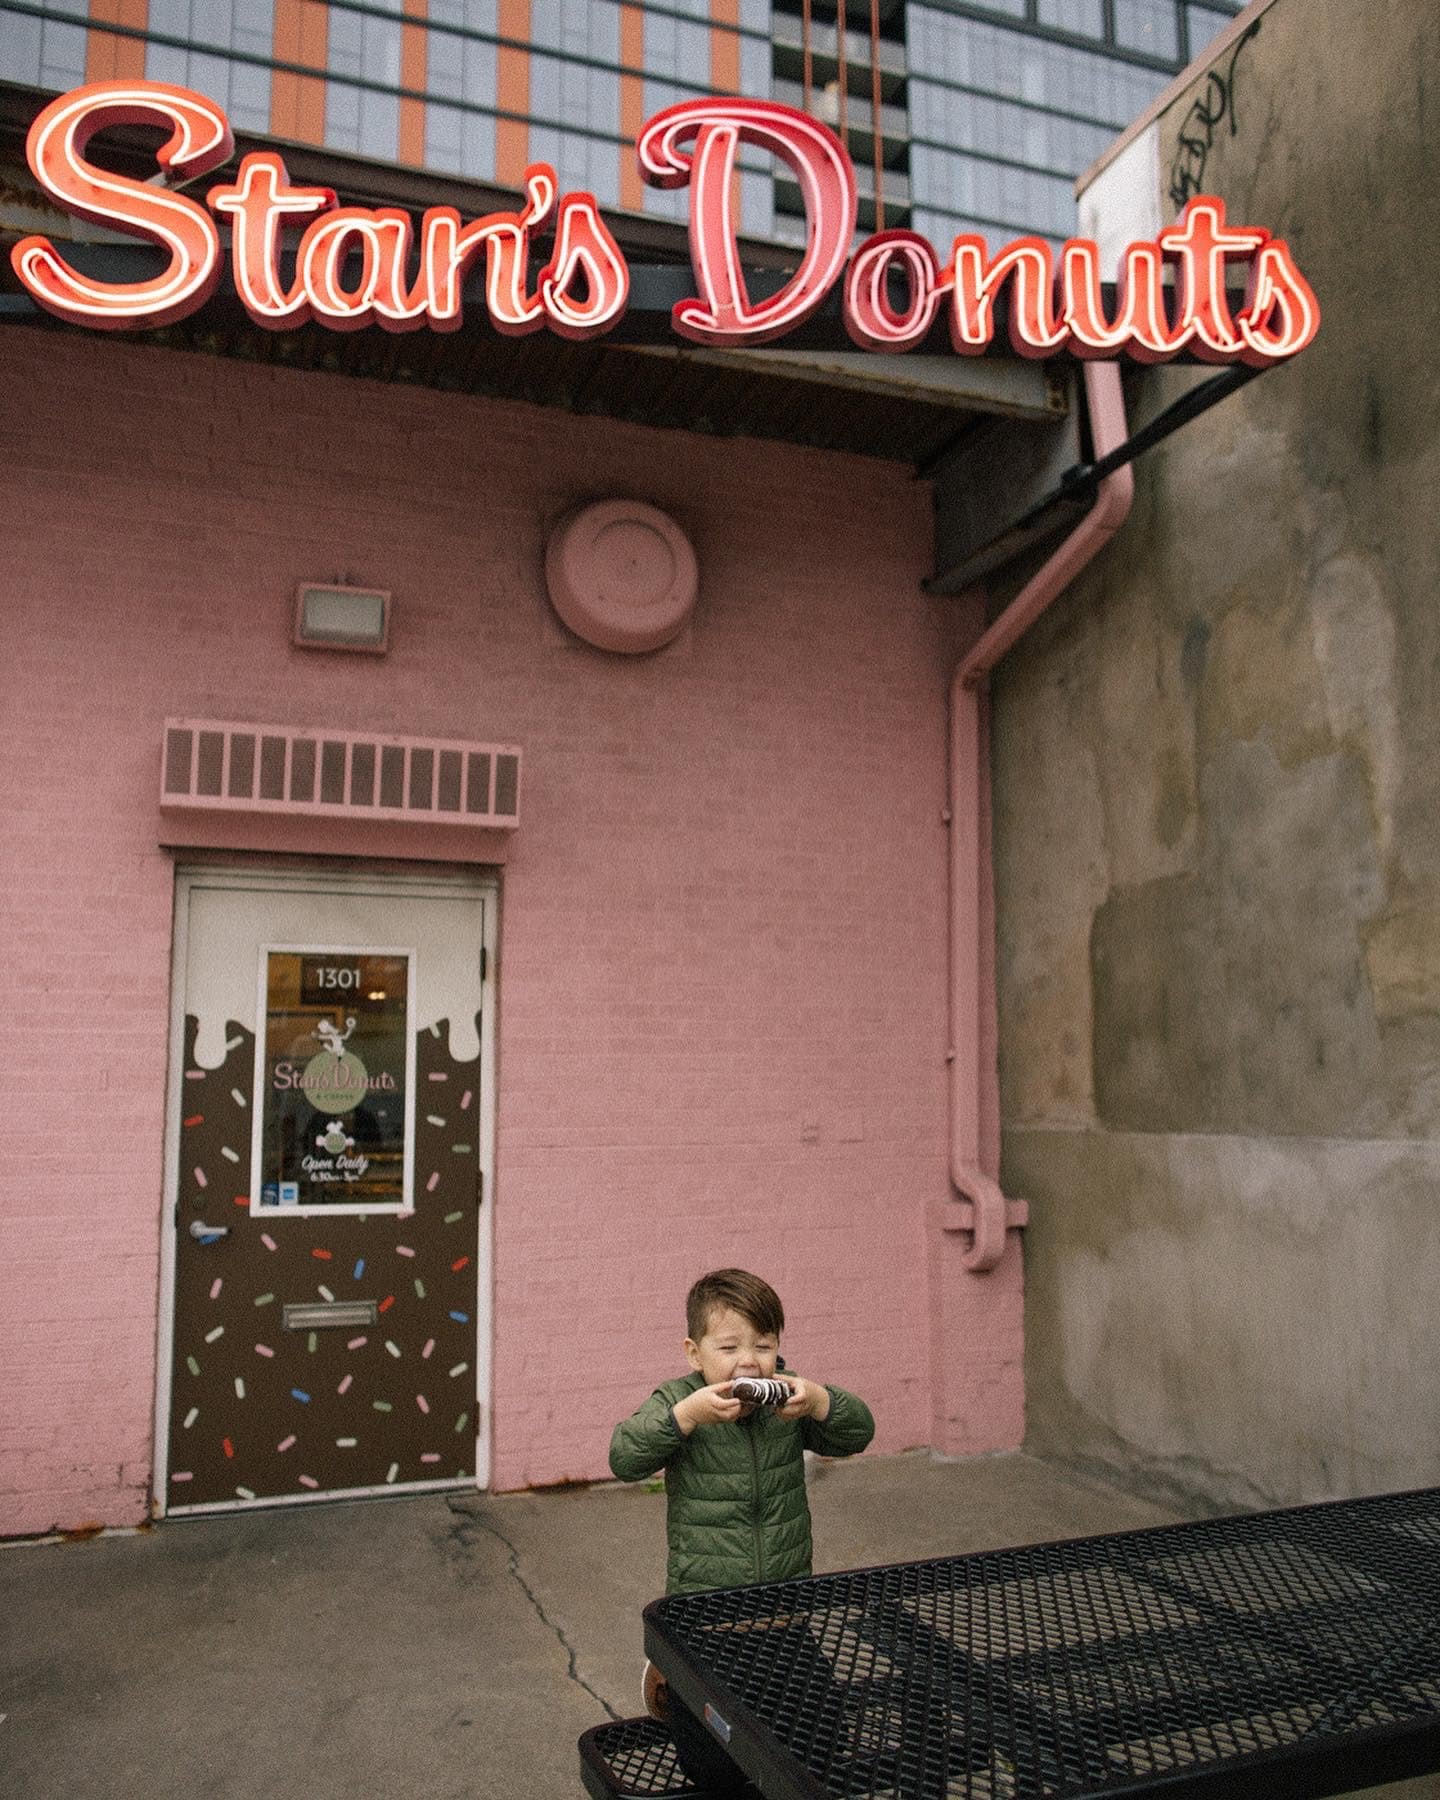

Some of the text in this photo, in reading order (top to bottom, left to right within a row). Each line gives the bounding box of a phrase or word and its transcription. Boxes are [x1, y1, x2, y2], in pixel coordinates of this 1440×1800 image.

[11, 80, 629, 340] Stan's
[637, 98, 1321, 364] Donuts
[316, 968, 361, 989] 1301
[330, 1061, 397, 1089] Donuts
[301, 1154, 368, 1175] Open Daily
